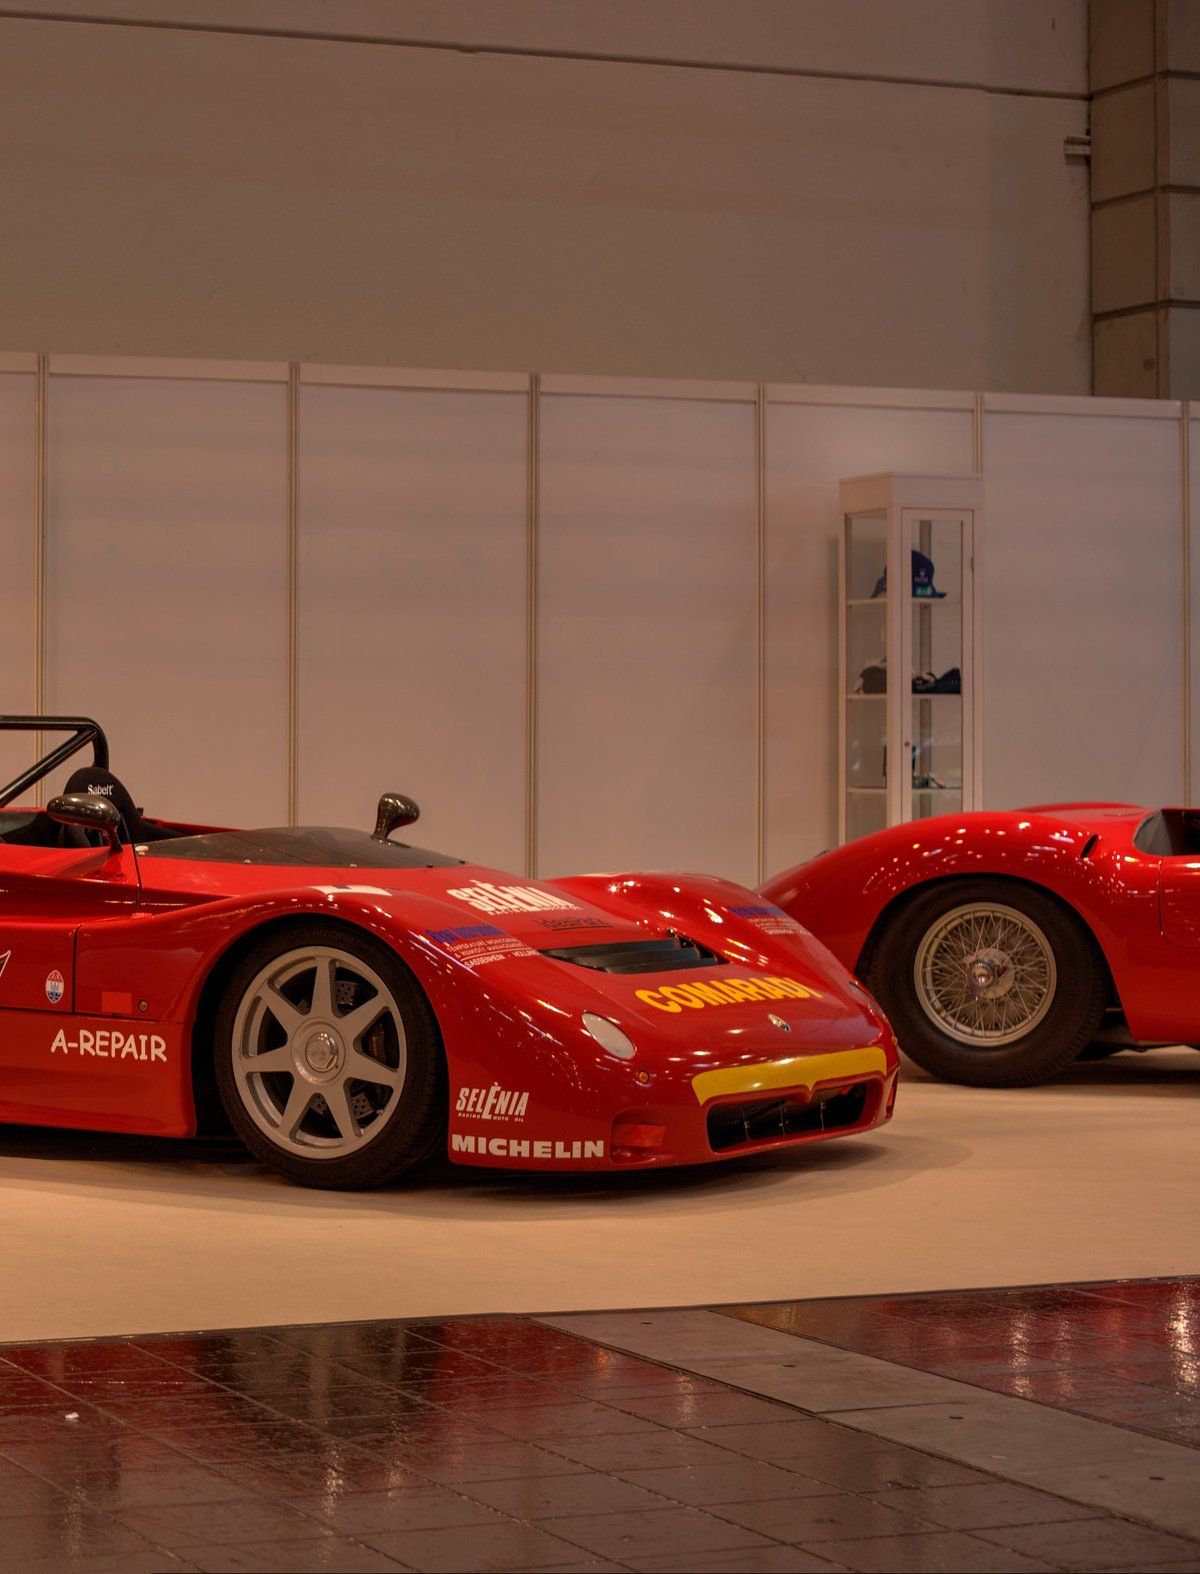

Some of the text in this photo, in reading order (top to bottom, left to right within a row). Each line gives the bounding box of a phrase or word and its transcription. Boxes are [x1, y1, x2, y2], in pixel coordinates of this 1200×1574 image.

[87, 784, 114, 796] Sabelt
[51, 1029, 168, 1062] A-REPAIR
[457, 1112, 482, 1120] RACING
[452, 1133, 605, 1159] MICHELIN
